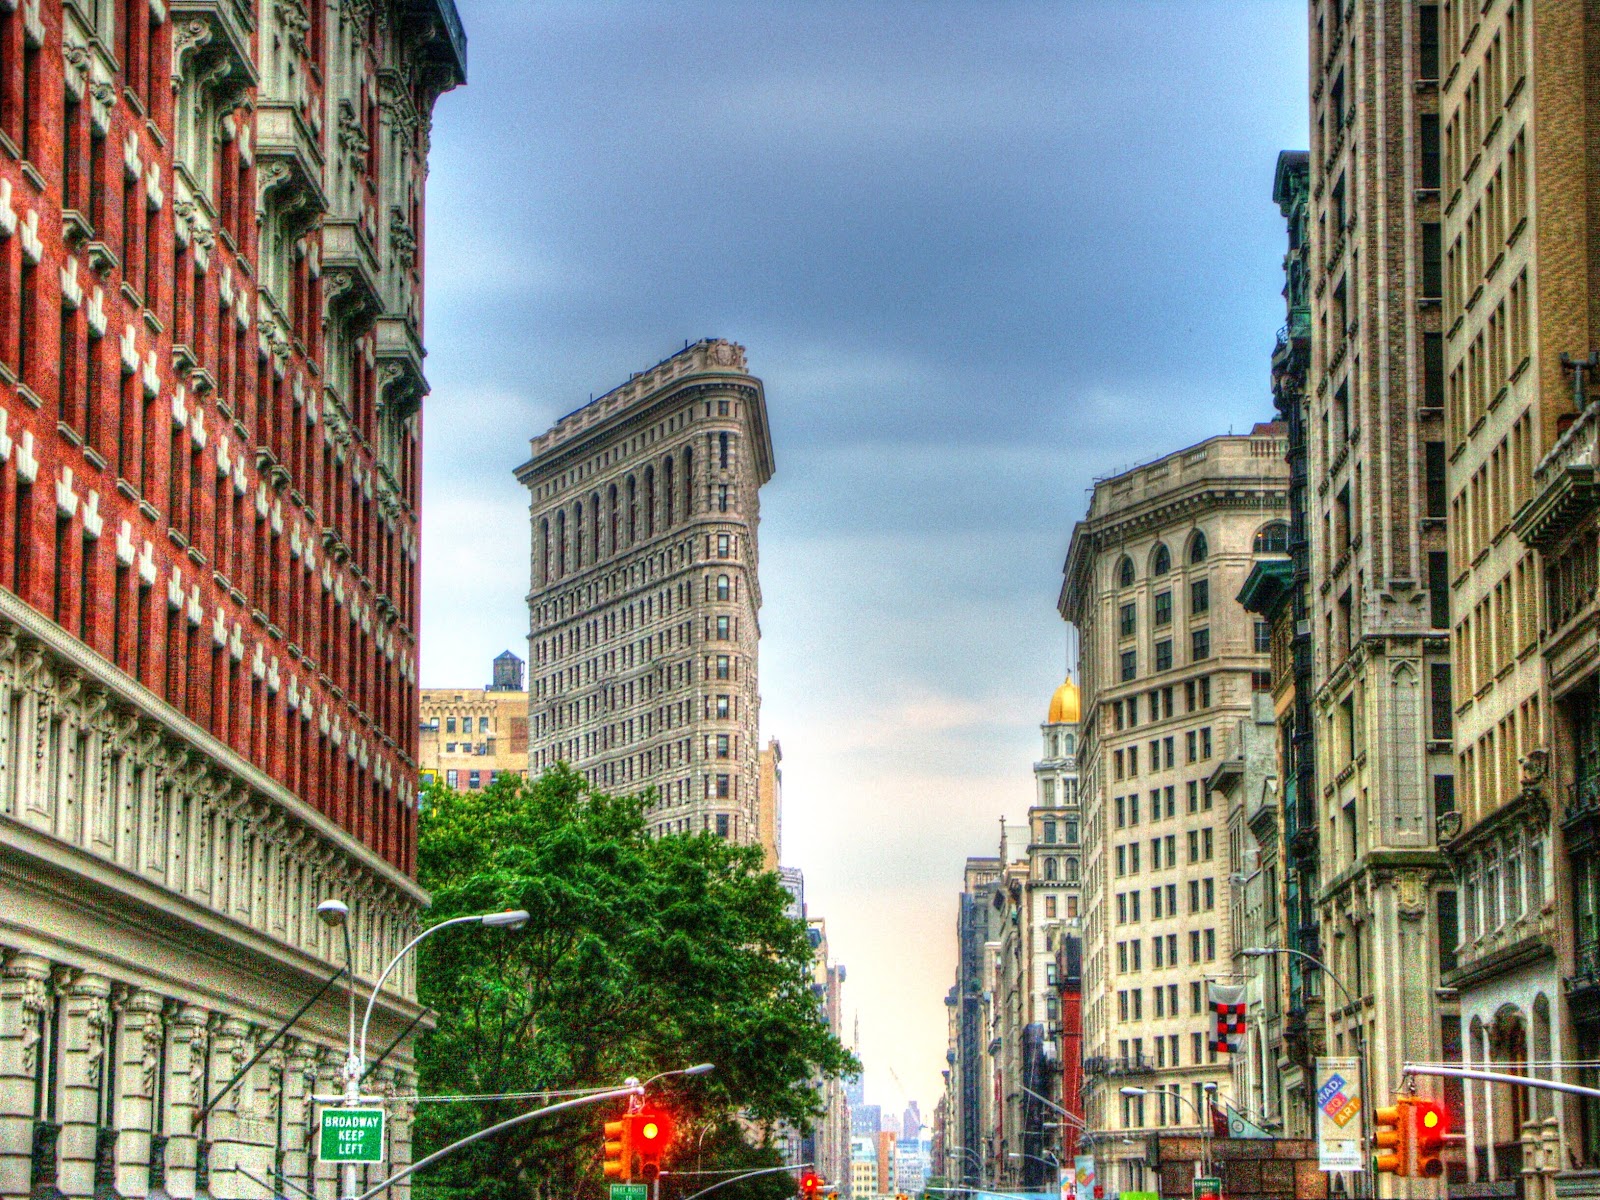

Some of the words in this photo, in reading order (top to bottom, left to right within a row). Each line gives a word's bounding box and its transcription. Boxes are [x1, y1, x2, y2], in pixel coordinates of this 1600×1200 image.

[1318, 1080, 1342, 1104] MAD.
[325, 1116, 378, 1128] BROADWAY
[338, 1130, 364, 1141] KEEP
[338, 1144, 363, 1154] LEFT
